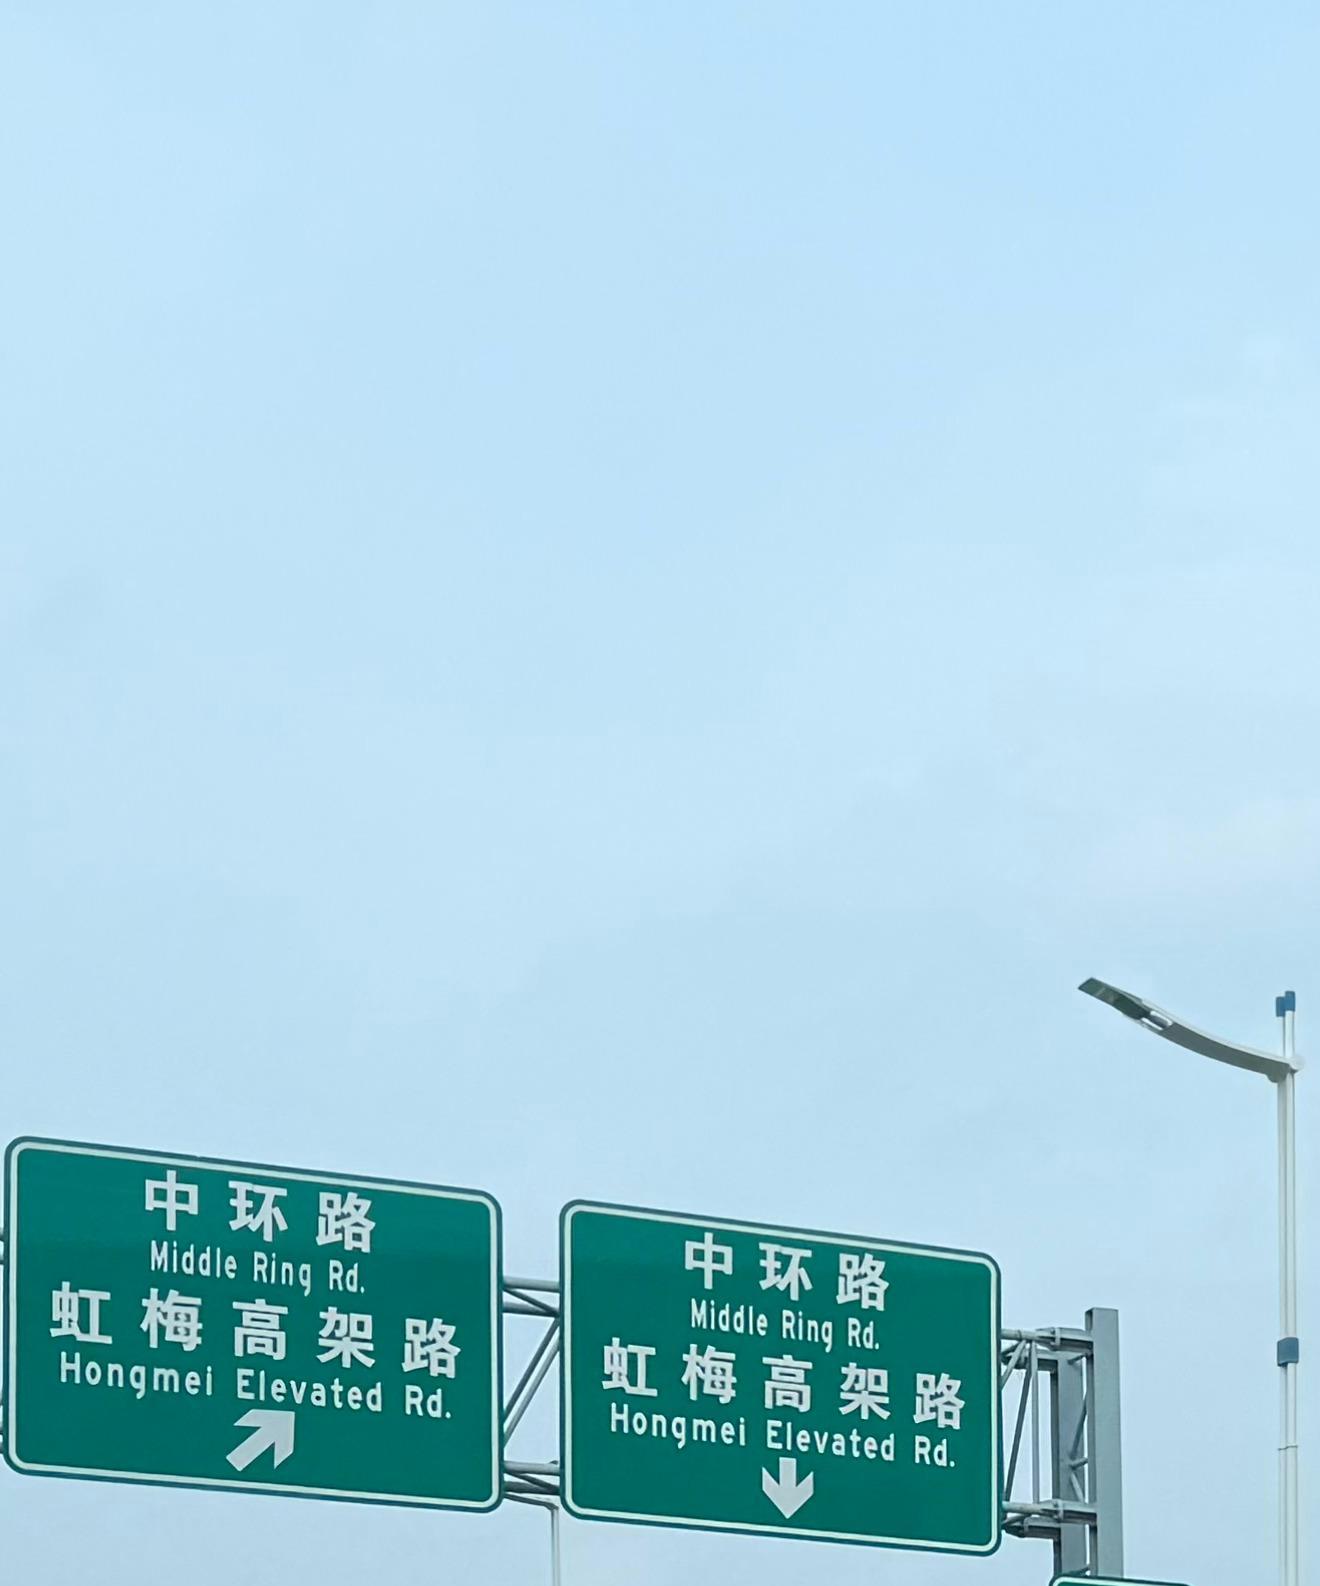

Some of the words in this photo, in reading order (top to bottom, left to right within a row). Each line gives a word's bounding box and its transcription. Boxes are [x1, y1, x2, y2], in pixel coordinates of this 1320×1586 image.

[145, 1170, 376, 1253] 中环路
[150, 1240, 237, 1280] Middle
[253, 1252, 311, 1296] Ring
[329, 1260, 365, 1294] Rd.
[684, 1232, 889, 1312] 中环路
[50, 1281, 461, 1379] 虹梅高架路
[691, 1298, 768, 1337] Middle
[782, 1310, 833, 1353] Ring
[847, 1317, 880, 1350] Rd.
[60, 1351, 213, 1399] Hongmei
[236, 1369, 382, 1413] Elevated
[405, 1385, 452, 1419] Rd.
[602, 1337, 965, 1430] 虹梅高架路
[610, 1402, 746, 1449] Hongmei
[767, 1420, 895, 1462] Elevated
[914, 1436, 955, 1468] Rd.
